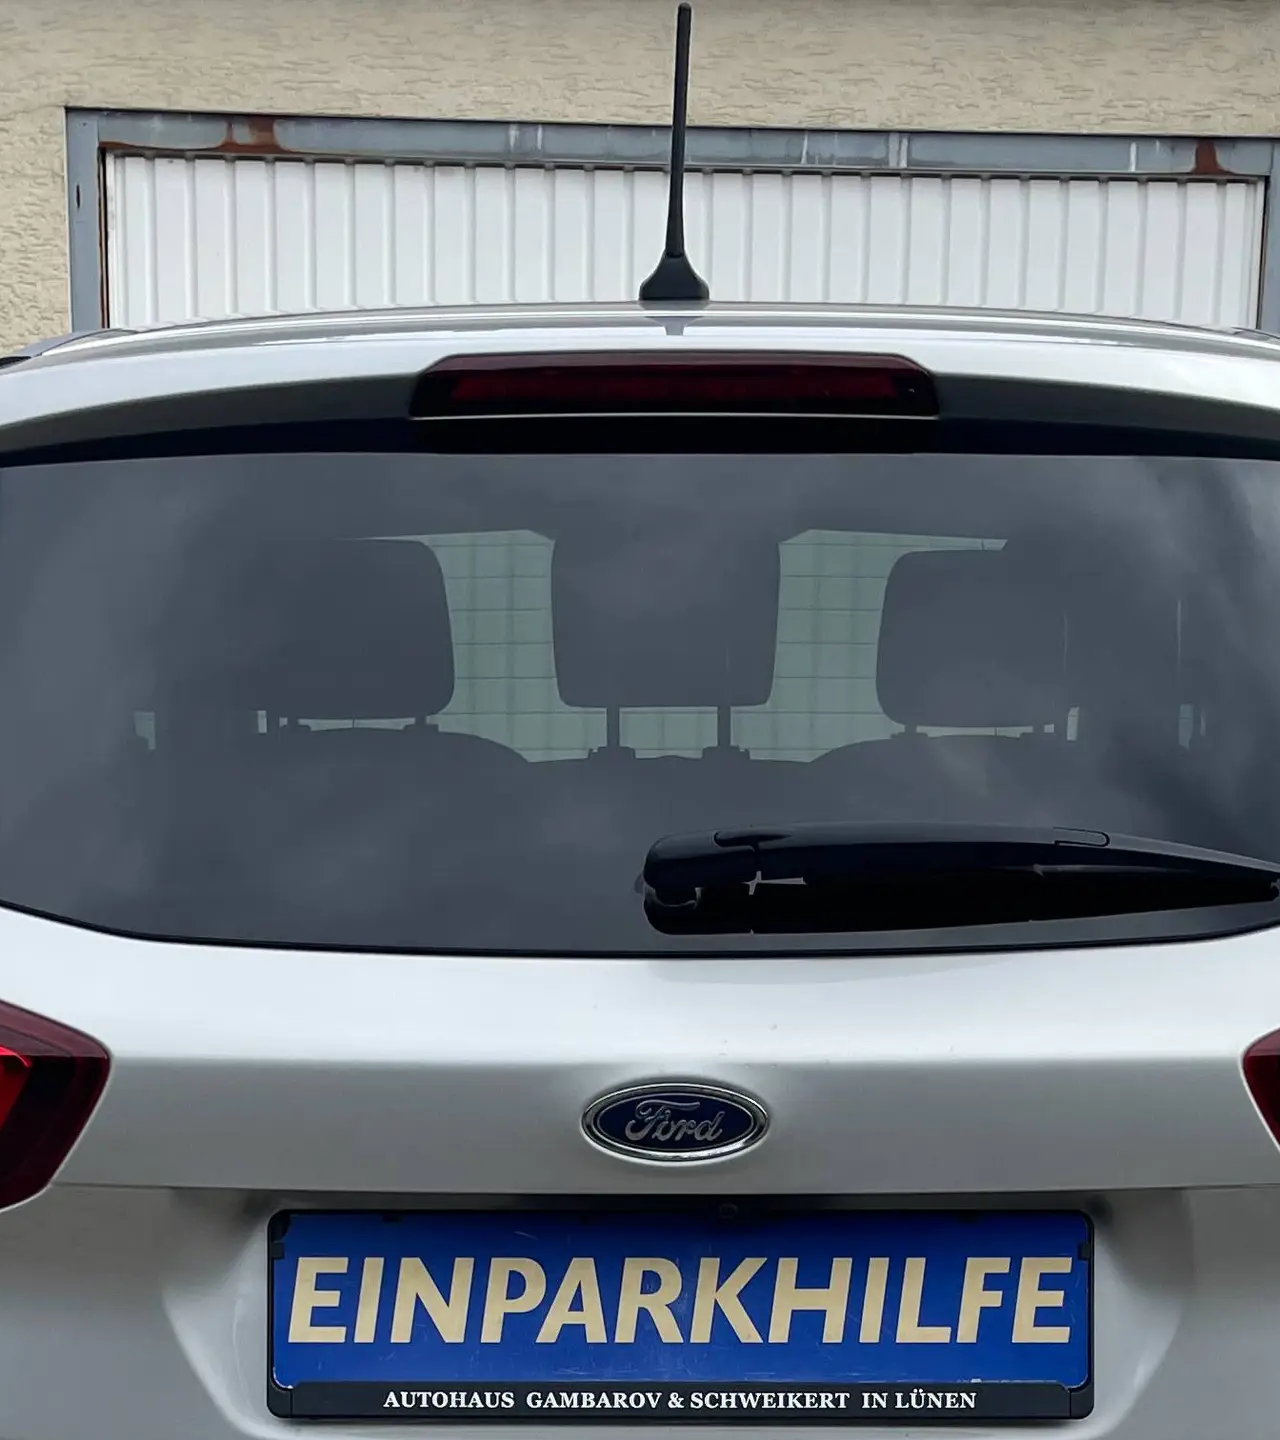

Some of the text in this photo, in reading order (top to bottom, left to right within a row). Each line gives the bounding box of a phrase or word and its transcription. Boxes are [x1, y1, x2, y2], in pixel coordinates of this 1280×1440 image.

[624, 1099, 725, 1142] Ford
[287, 1256, 1072, 1345] EINPARKHILFE
[382, 1388, 978, 1409] AUTOHAUS GAMBAROV & SCHWEIKERT IN LÜNEN
